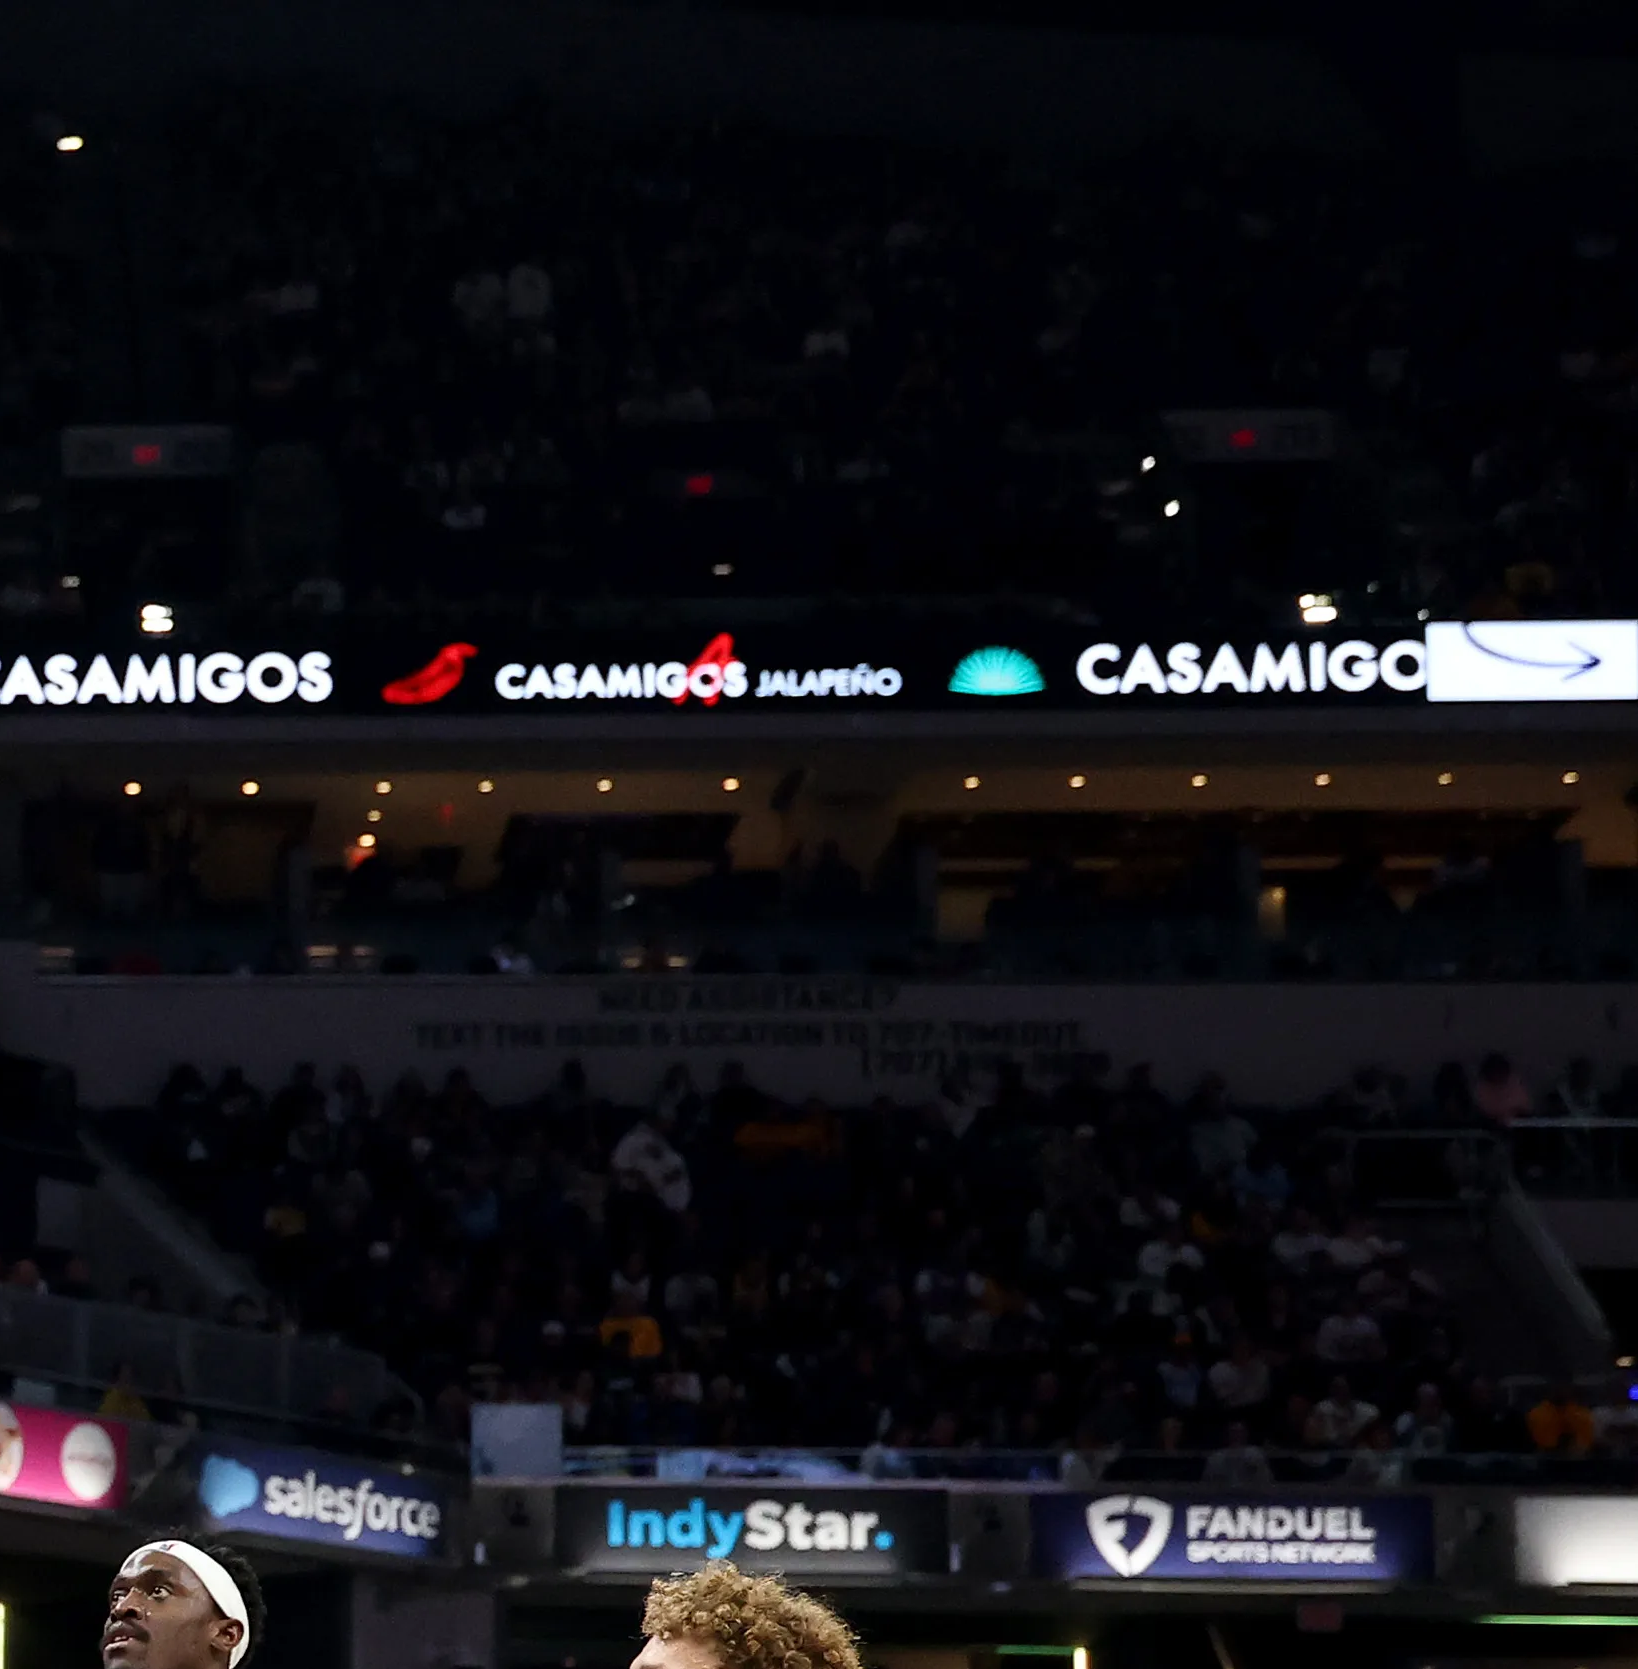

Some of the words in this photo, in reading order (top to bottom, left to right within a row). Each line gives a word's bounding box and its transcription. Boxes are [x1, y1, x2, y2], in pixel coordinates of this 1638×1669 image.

[494, 660, 748, 700] CASAMIGOS
[754, 660, 903, 698] JALAPEÑO
[1076, 640, 1427, 696] CASAMIGO
[263, 1468, 439, 1543] salesforce
[606, 1497, 896, 1559] IndyStar.
[1186, 1505, 1377, 1541] FANDUEL
